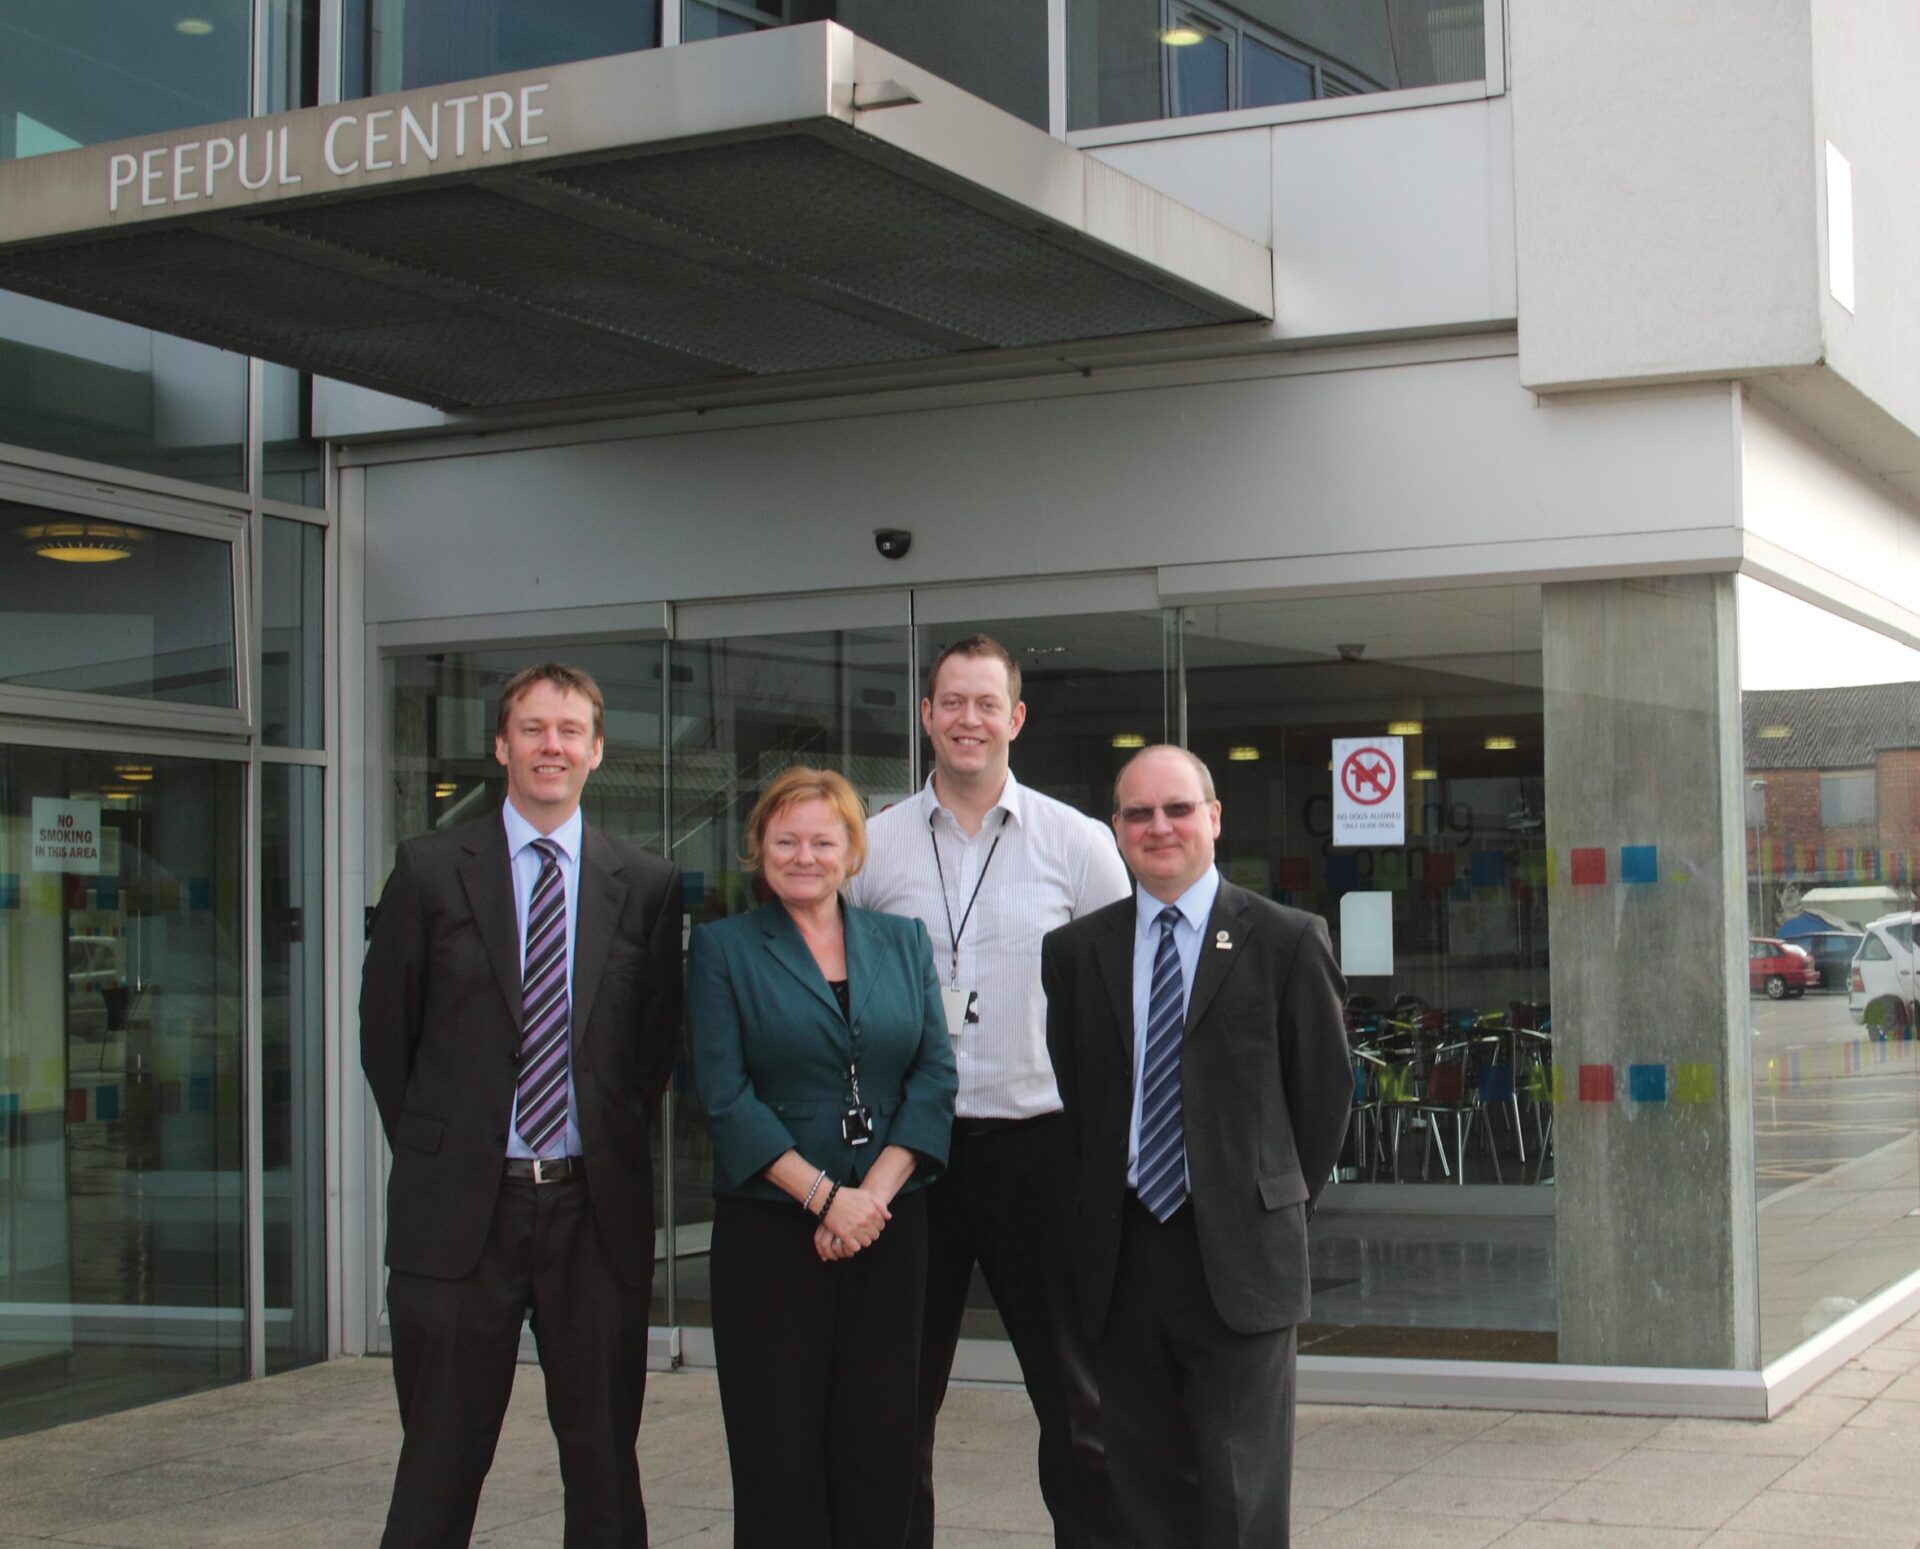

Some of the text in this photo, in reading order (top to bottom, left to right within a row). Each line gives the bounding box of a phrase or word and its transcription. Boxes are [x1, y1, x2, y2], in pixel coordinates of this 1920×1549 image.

[109, 83, 549, 212] PEEPUL CENTRE
[57, 815, 74, 828] NO
[1371, 812, 1401, 820] ALLOWED
[40, 829, 93, 843] SMOKING
[35, 846, 98, 859] IN THIS AREA
